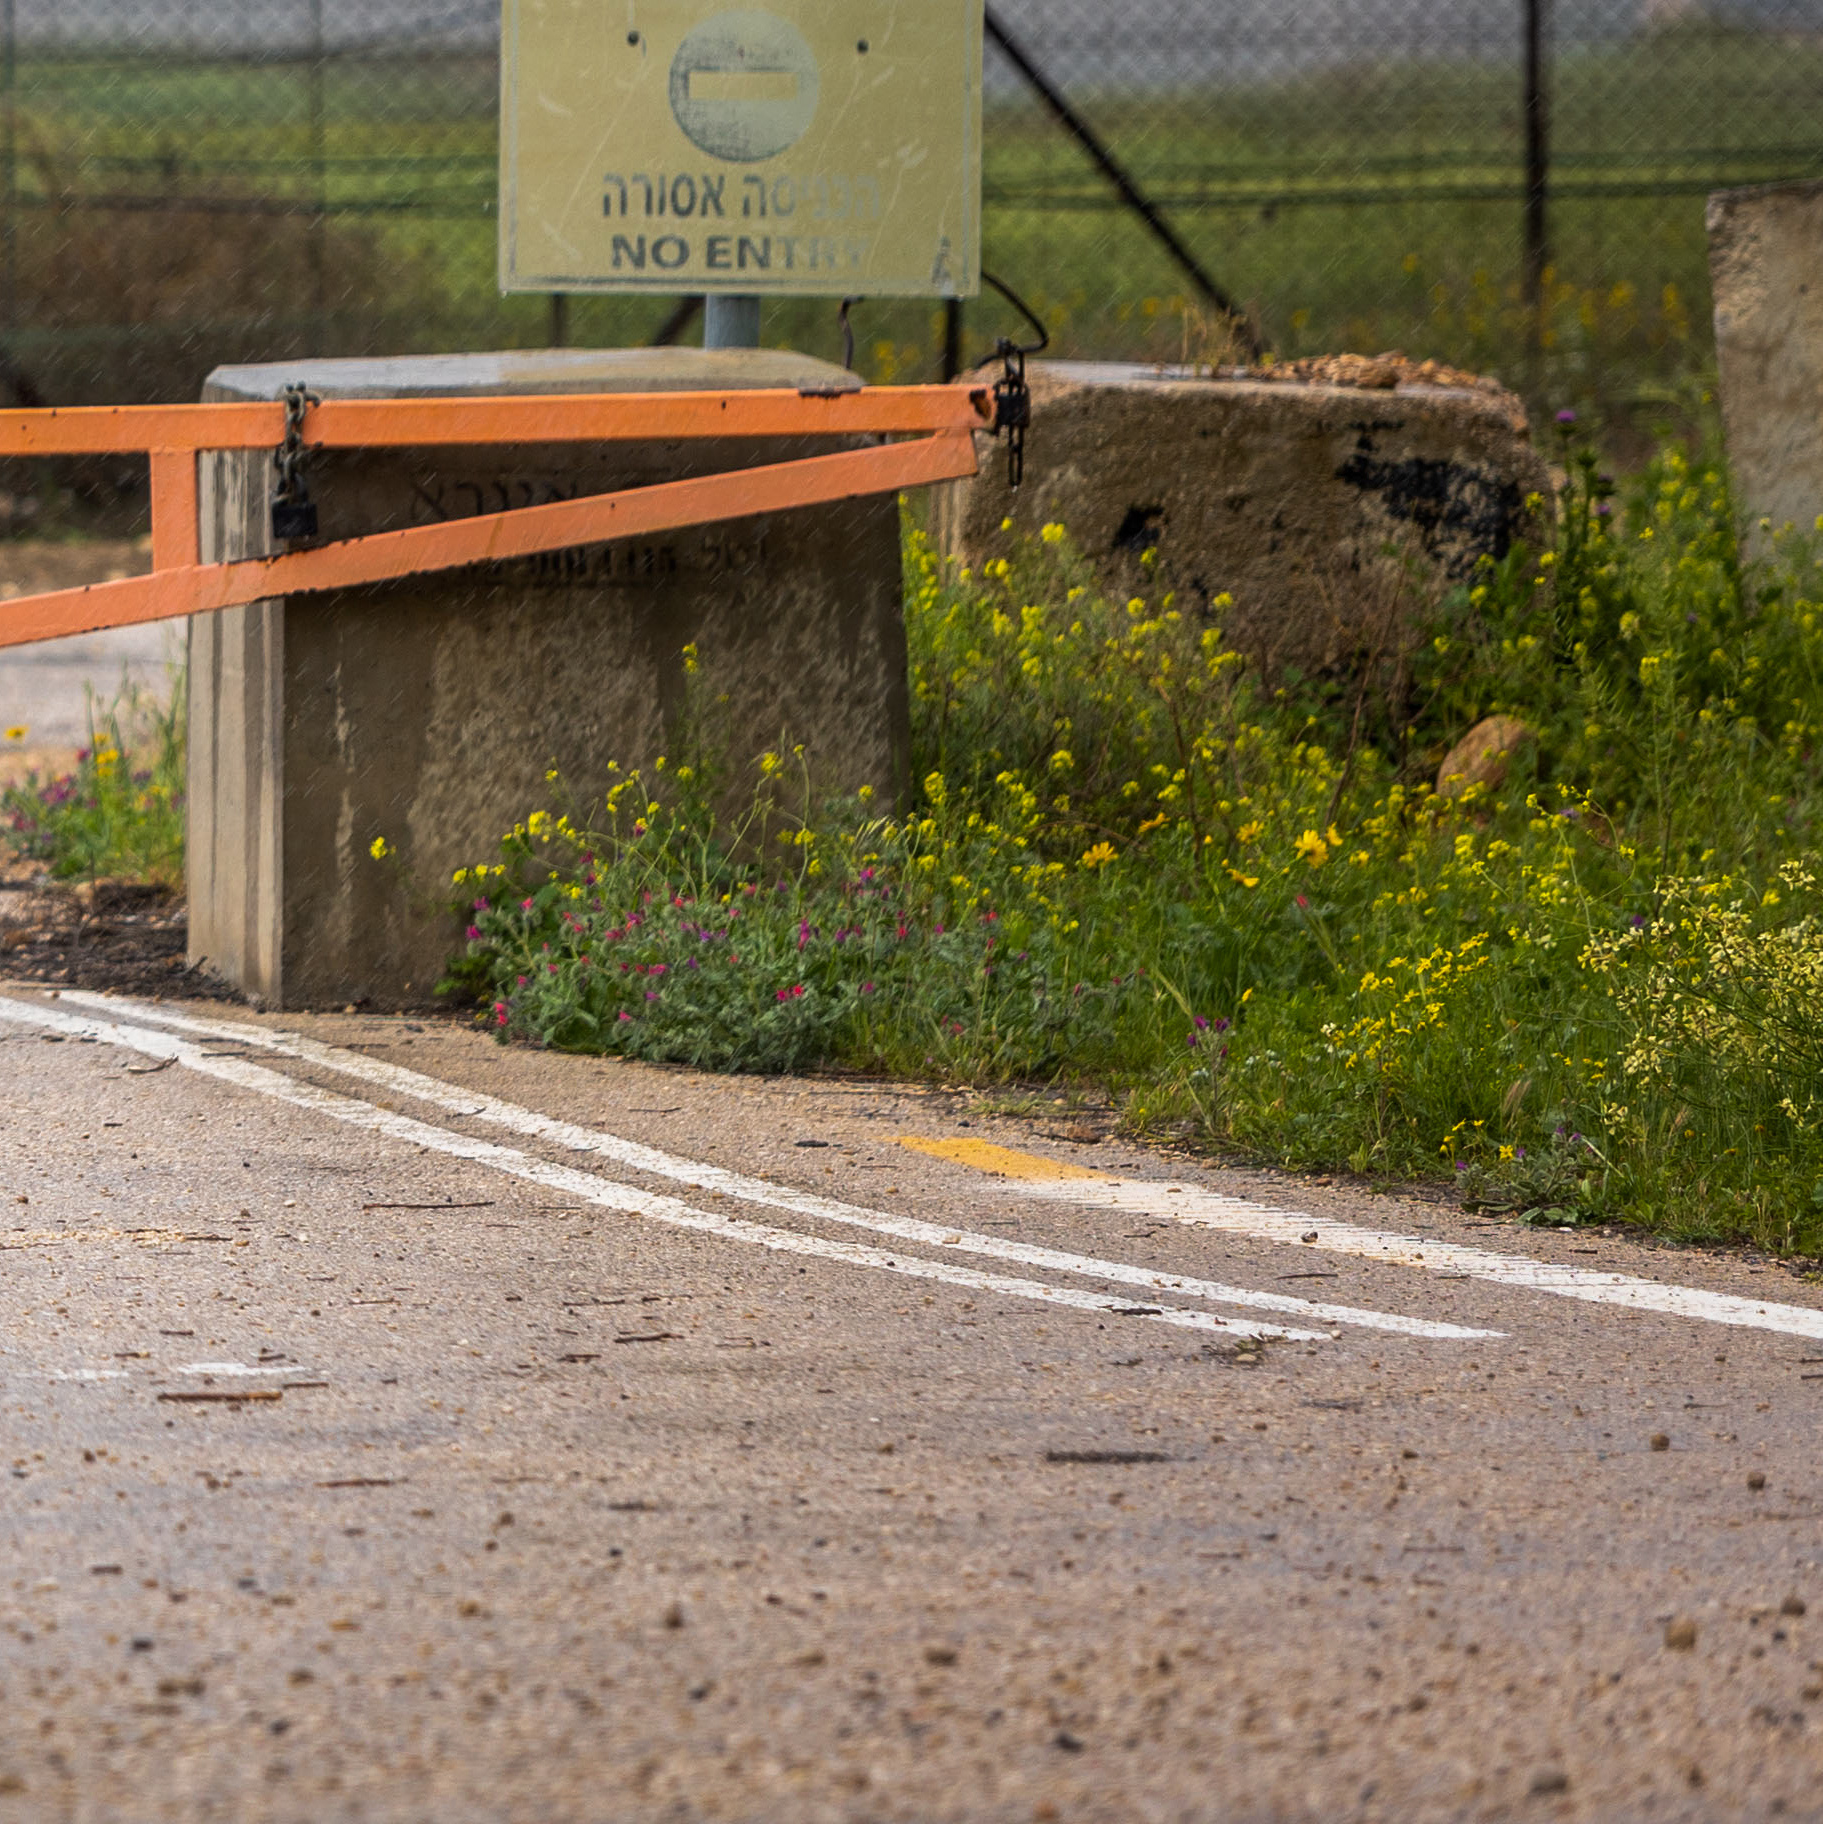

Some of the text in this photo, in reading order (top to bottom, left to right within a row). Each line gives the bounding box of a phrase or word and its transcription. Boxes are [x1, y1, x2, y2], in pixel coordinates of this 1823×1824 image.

[602, 172, 880, 219] הכניסה אסורה
[611, 235, 870, 271] NO ENTRY
